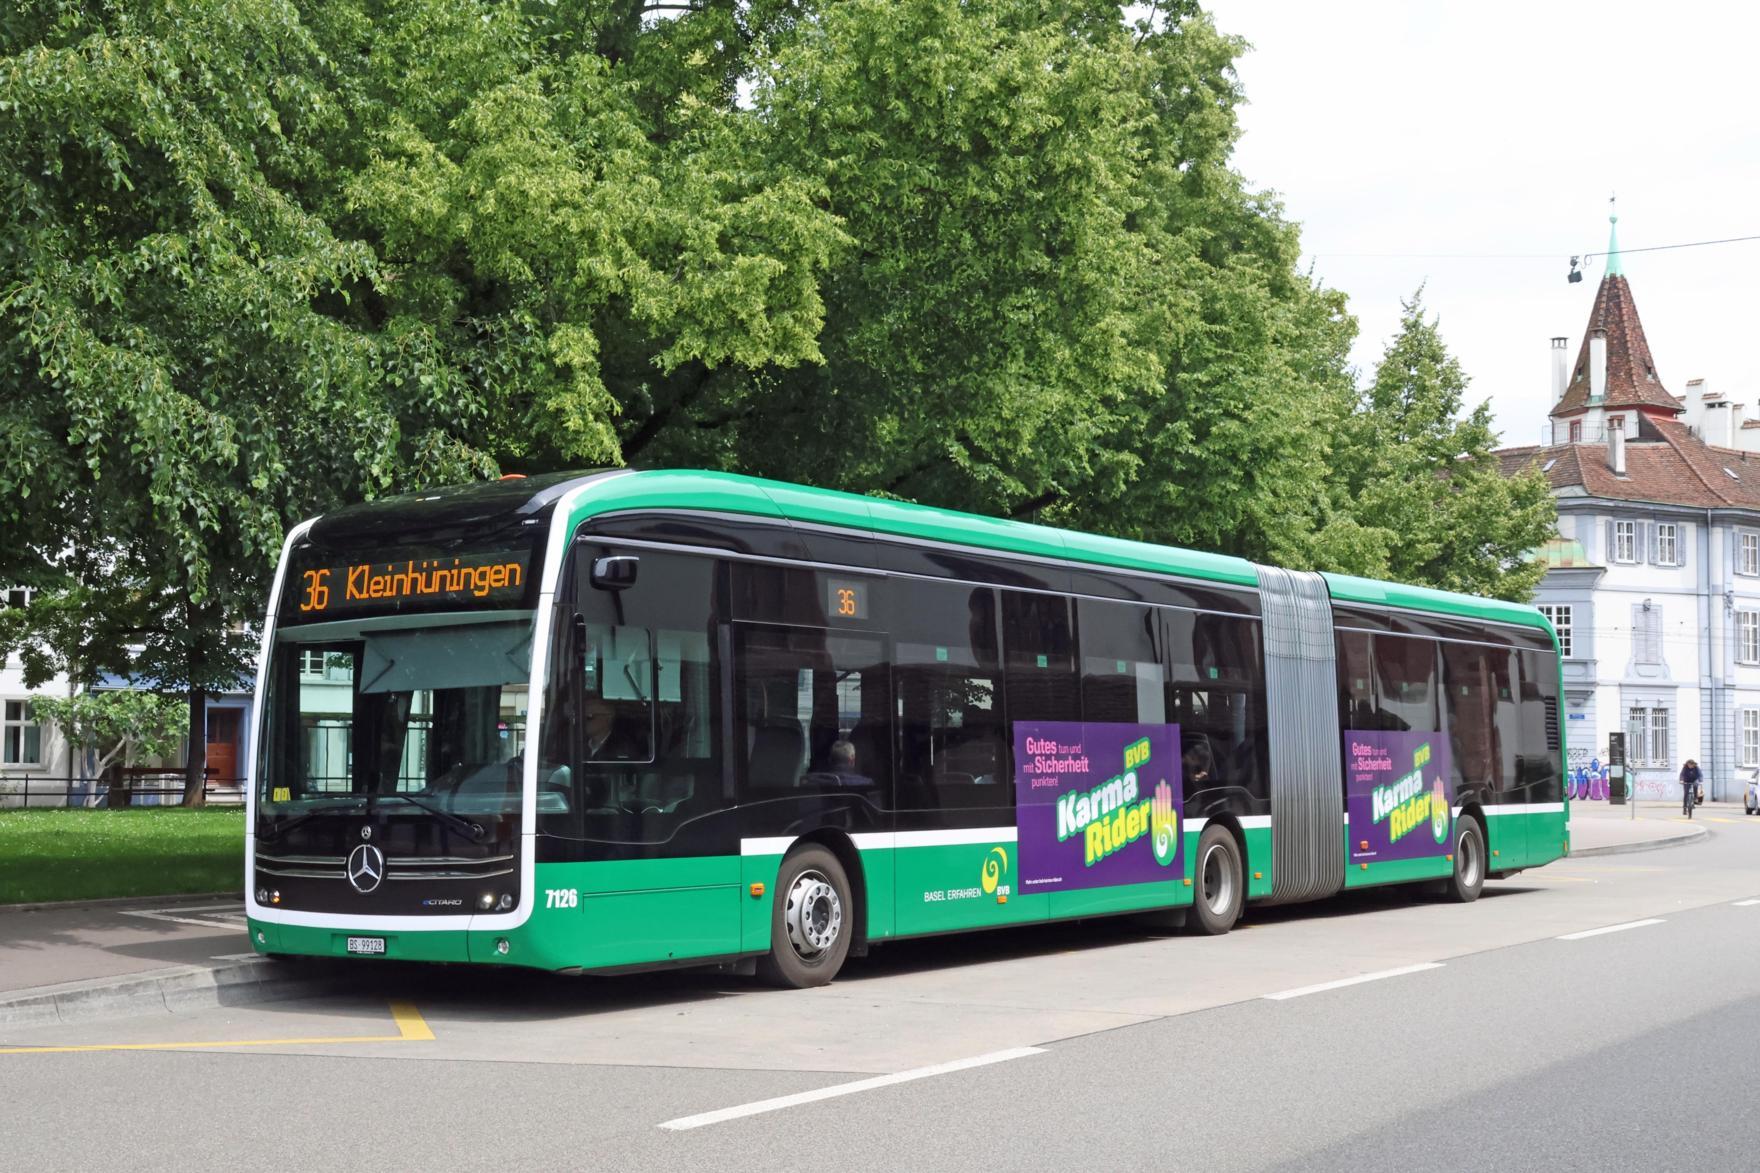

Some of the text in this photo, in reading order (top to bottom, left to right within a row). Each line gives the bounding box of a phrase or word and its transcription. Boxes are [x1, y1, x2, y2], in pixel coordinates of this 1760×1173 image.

[300, 559, 521, 611] 36 Kleinhüningen
[837, 589, 855, 615] 36
[1026, 737, 1057, 754] Gutes
[1125, 740, 1150, 768] BVB
[1035, 756, 1089, 773] Sicherheit
[1058, 772, 1138, 837] Karma
[1372, 770, 1423, 824] Karma
[1390, 793, 1431, 841] Rider
[1086, 801, 1150, 863] Rider
[545, 889, 578, 908] 7126
[924, 887, 982, 902] BASEL ERFAHREN
[997, 885, 1010, 895] BVB
